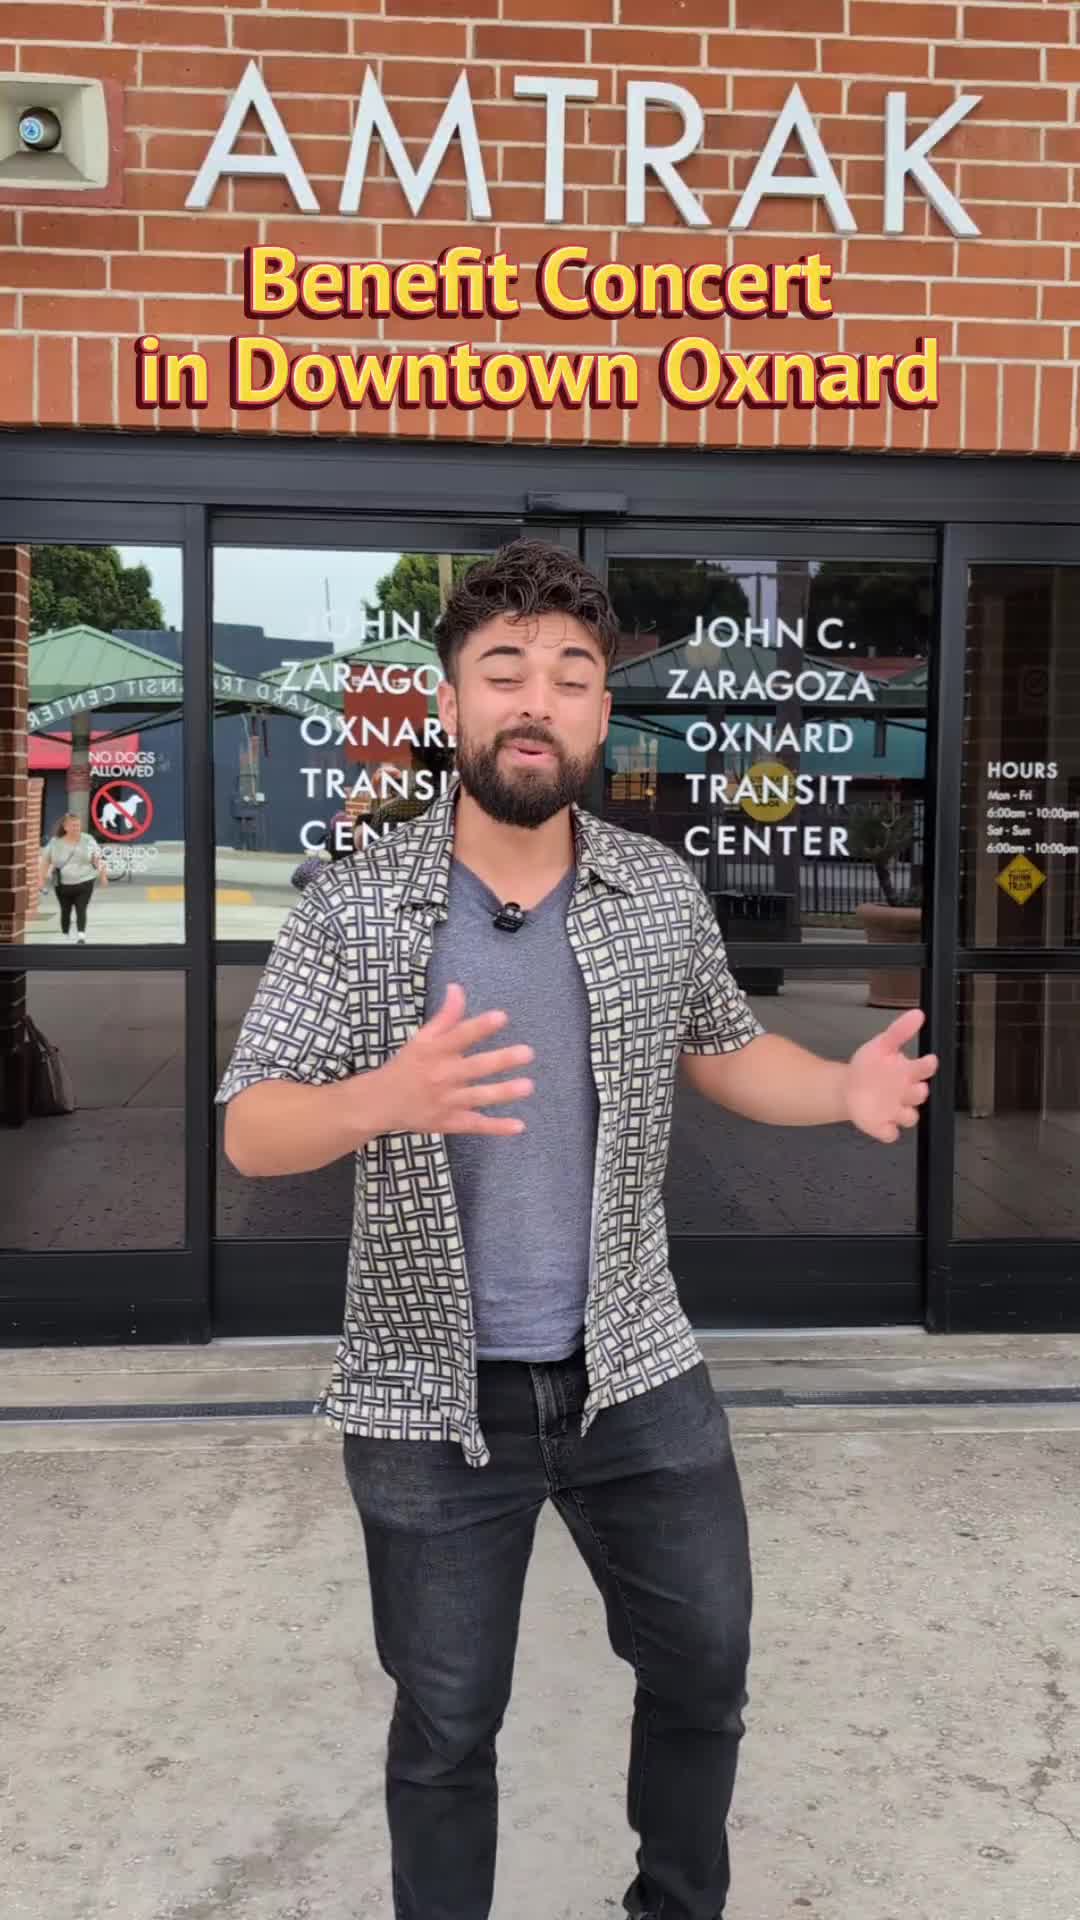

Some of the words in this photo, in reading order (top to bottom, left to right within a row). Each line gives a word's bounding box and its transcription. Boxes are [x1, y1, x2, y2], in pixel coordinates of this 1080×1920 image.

[184, 60, 983, 237] AMTRAK
[688, 616, 803, 649] JOHN
[817, 618, 856, 649] C.
[280, 661, 444, 696] ZARAGO
[666, 669, 875, 702] ZARAGOZA
[685, 721, 854, 753] OXNARD
[88, 751, 112, 764] NO
[115, 751, 155, 764] DOGS
[89, 765, 154, 778] ALLOWED
[987, 761, 1058, 779] HOURS
[685, 774, 853, 805] TRANSIT
[987, 789, 1011, 801] Mon
[1019, 789, 1033, 801] Fri
[986, 807, 1026, 819] 6:00am
[1036, 807, 1079, 821] 10:00pm
[684, 825, 850, 857] CENTER
[986, 823, 1004, 836] Sat
[1011, 823, 1032, 837] Sun
[986, 842, 1025, 854] 6:00am
[1035, 842, 1079, 856] 10:00pm
